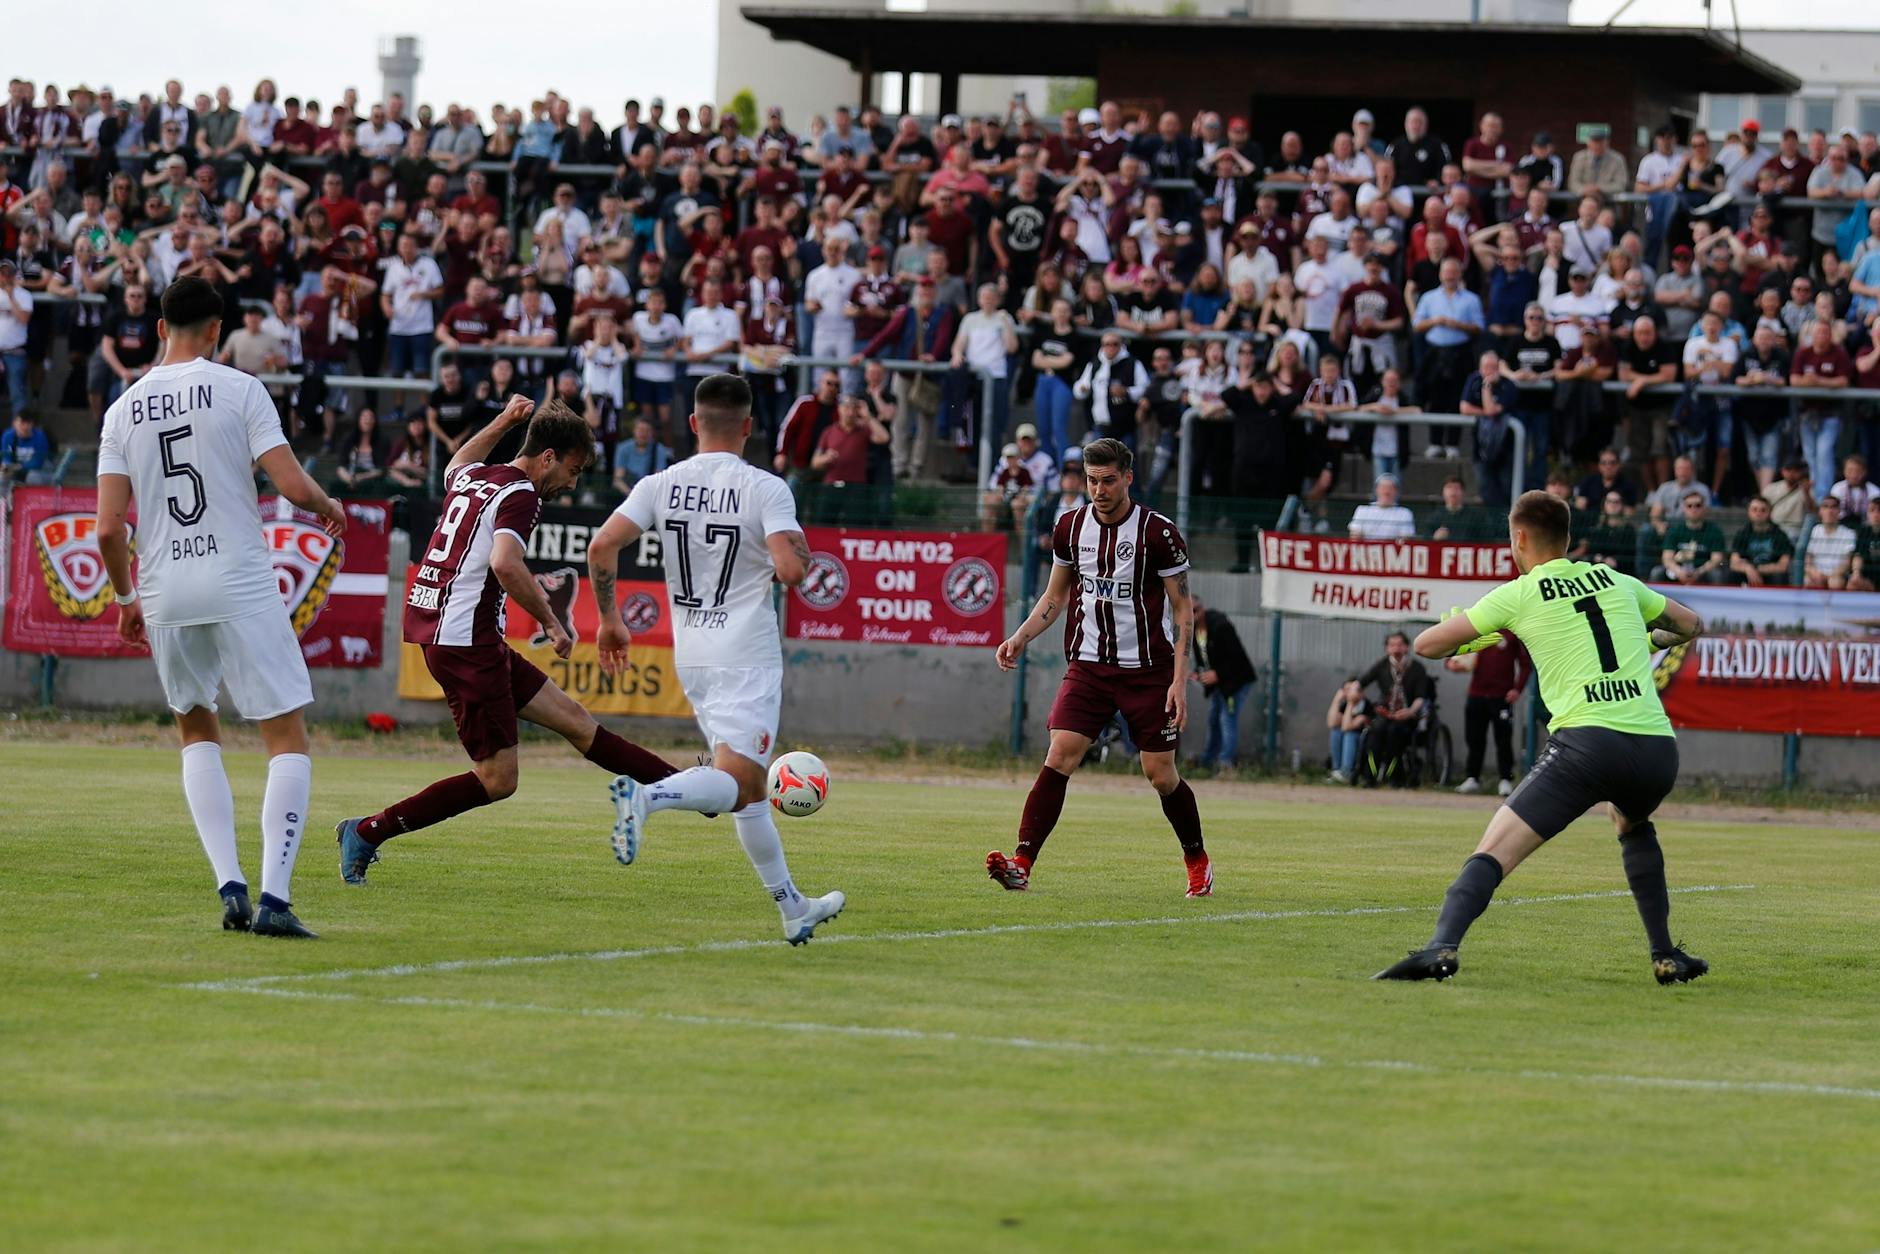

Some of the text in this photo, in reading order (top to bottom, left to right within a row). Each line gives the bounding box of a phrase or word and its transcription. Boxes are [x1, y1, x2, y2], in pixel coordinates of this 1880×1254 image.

[132, 384, 213, 424] BERLIN
[159, 424, 208, 527] 5
[451, 475, 501, 500] BFC
[669, 485, 741, 513] BERLIN
[43, 519, 98, 548] BF
[428, 495, 470, 562] 9
[525, 523, 602, 562] INE
[173, 534, 219, 561] BACA
[262, 527, 328, 563] FC
[840, 538, 955, 564] TEAM'02
[1265, 536, 1513, 577] BFC DYNAMO FANS
[665, 519, 741, 608] 17
[875, 569, 917, 592] ON
[1084, 577, 1133, 599] DWB
[1538, 568, 1616, 601] BERLIN
[684, 608, 729, 629] MEYER
[857, 598, 933, 621] TOUR
[1573, 595, 1620, 673] 1
[1696, 636, 1834, 682] TRADITION
[1583, 676, 1642, 703] KÜHN
[789, 799, 812, 809] JAKO
